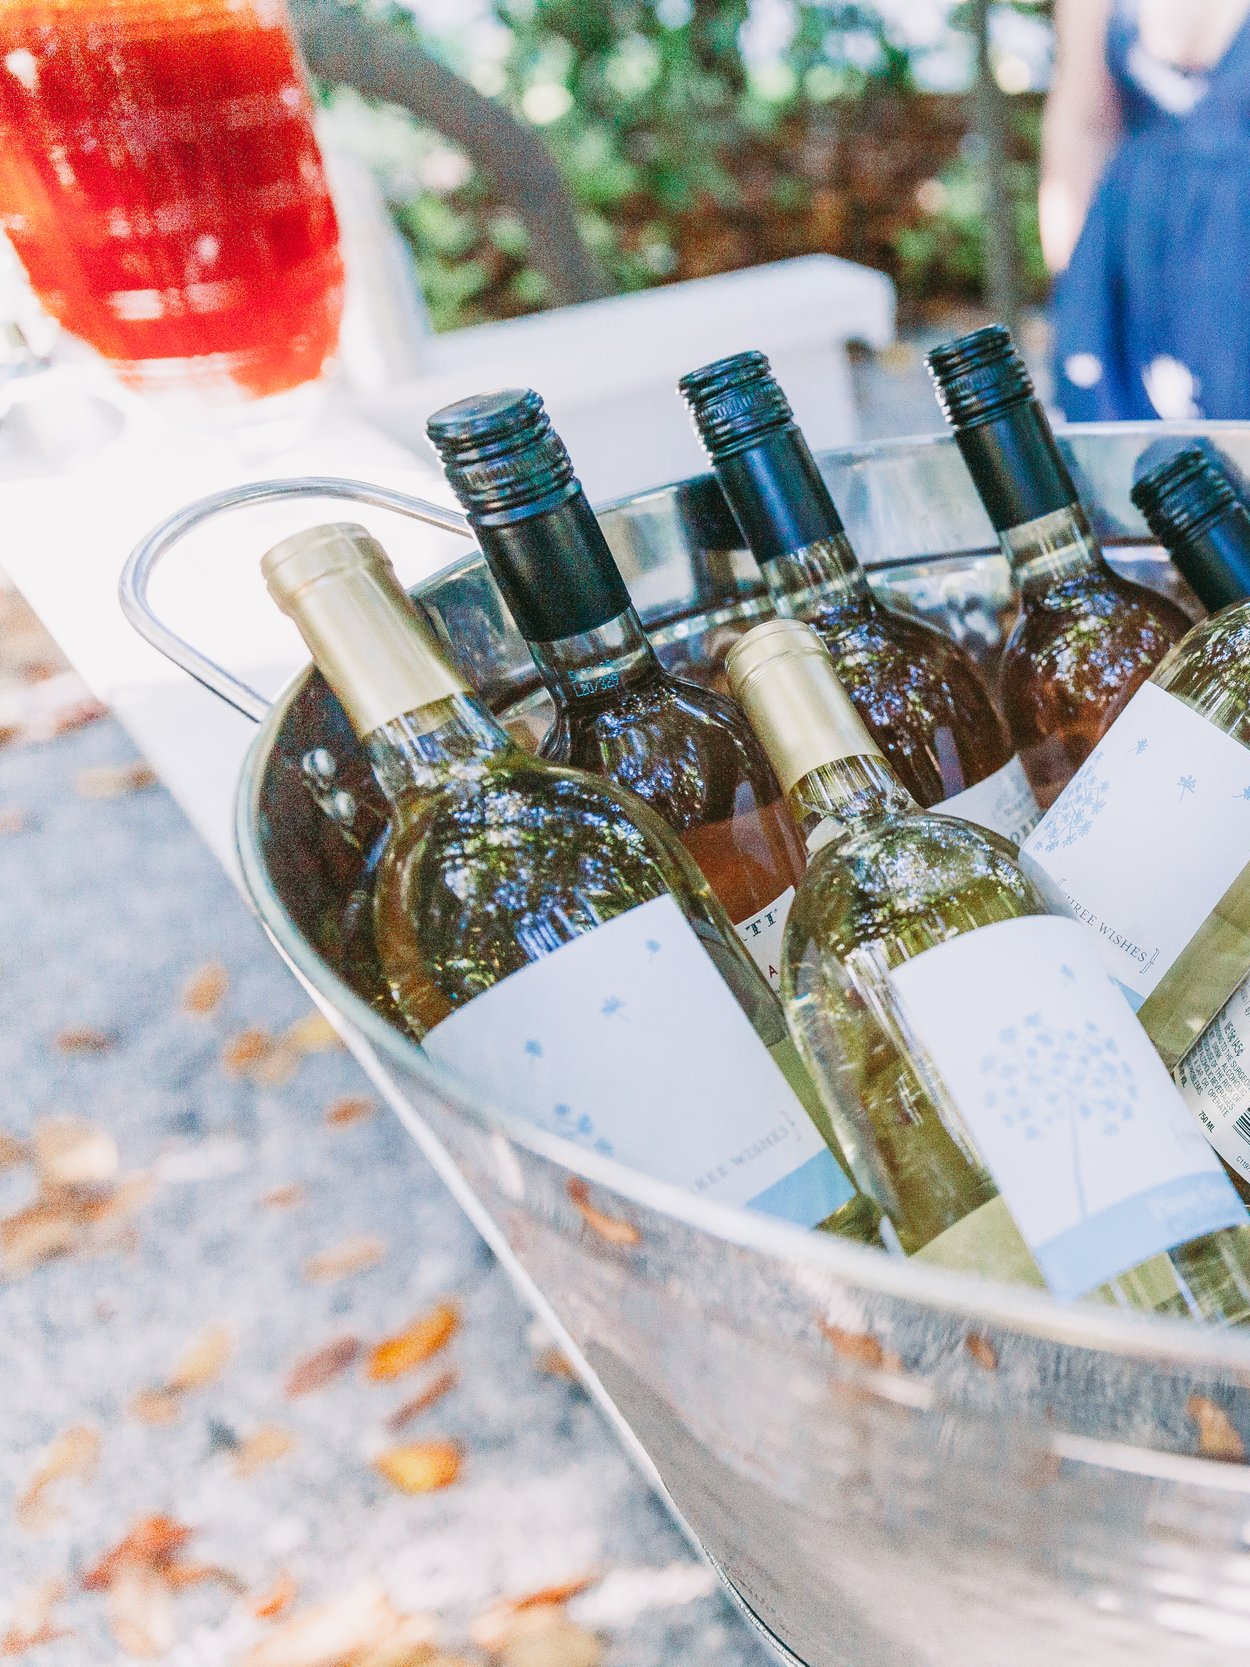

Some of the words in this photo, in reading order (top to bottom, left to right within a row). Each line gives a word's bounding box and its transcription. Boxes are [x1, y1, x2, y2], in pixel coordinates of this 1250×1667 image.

[1065, 894, 1097, 927] REE
[1224, 1049, 1233, 1062] THE
[1210, 1076, 1235, 1110] BEVERAGES
[1215, 1067, 1225, 1080] THE
[1222, 1078, 1234, 1094] RISK
[1233, 1093, 1242, 1102] OF
[1221, 1062, 1247, 1097] ALCOHOLIC
[1208, 1088, 1229, 1117] OPERATE
[1198, 1110, 1208, 1123] 750
[1205, 1121, 1215, 1133] ML
